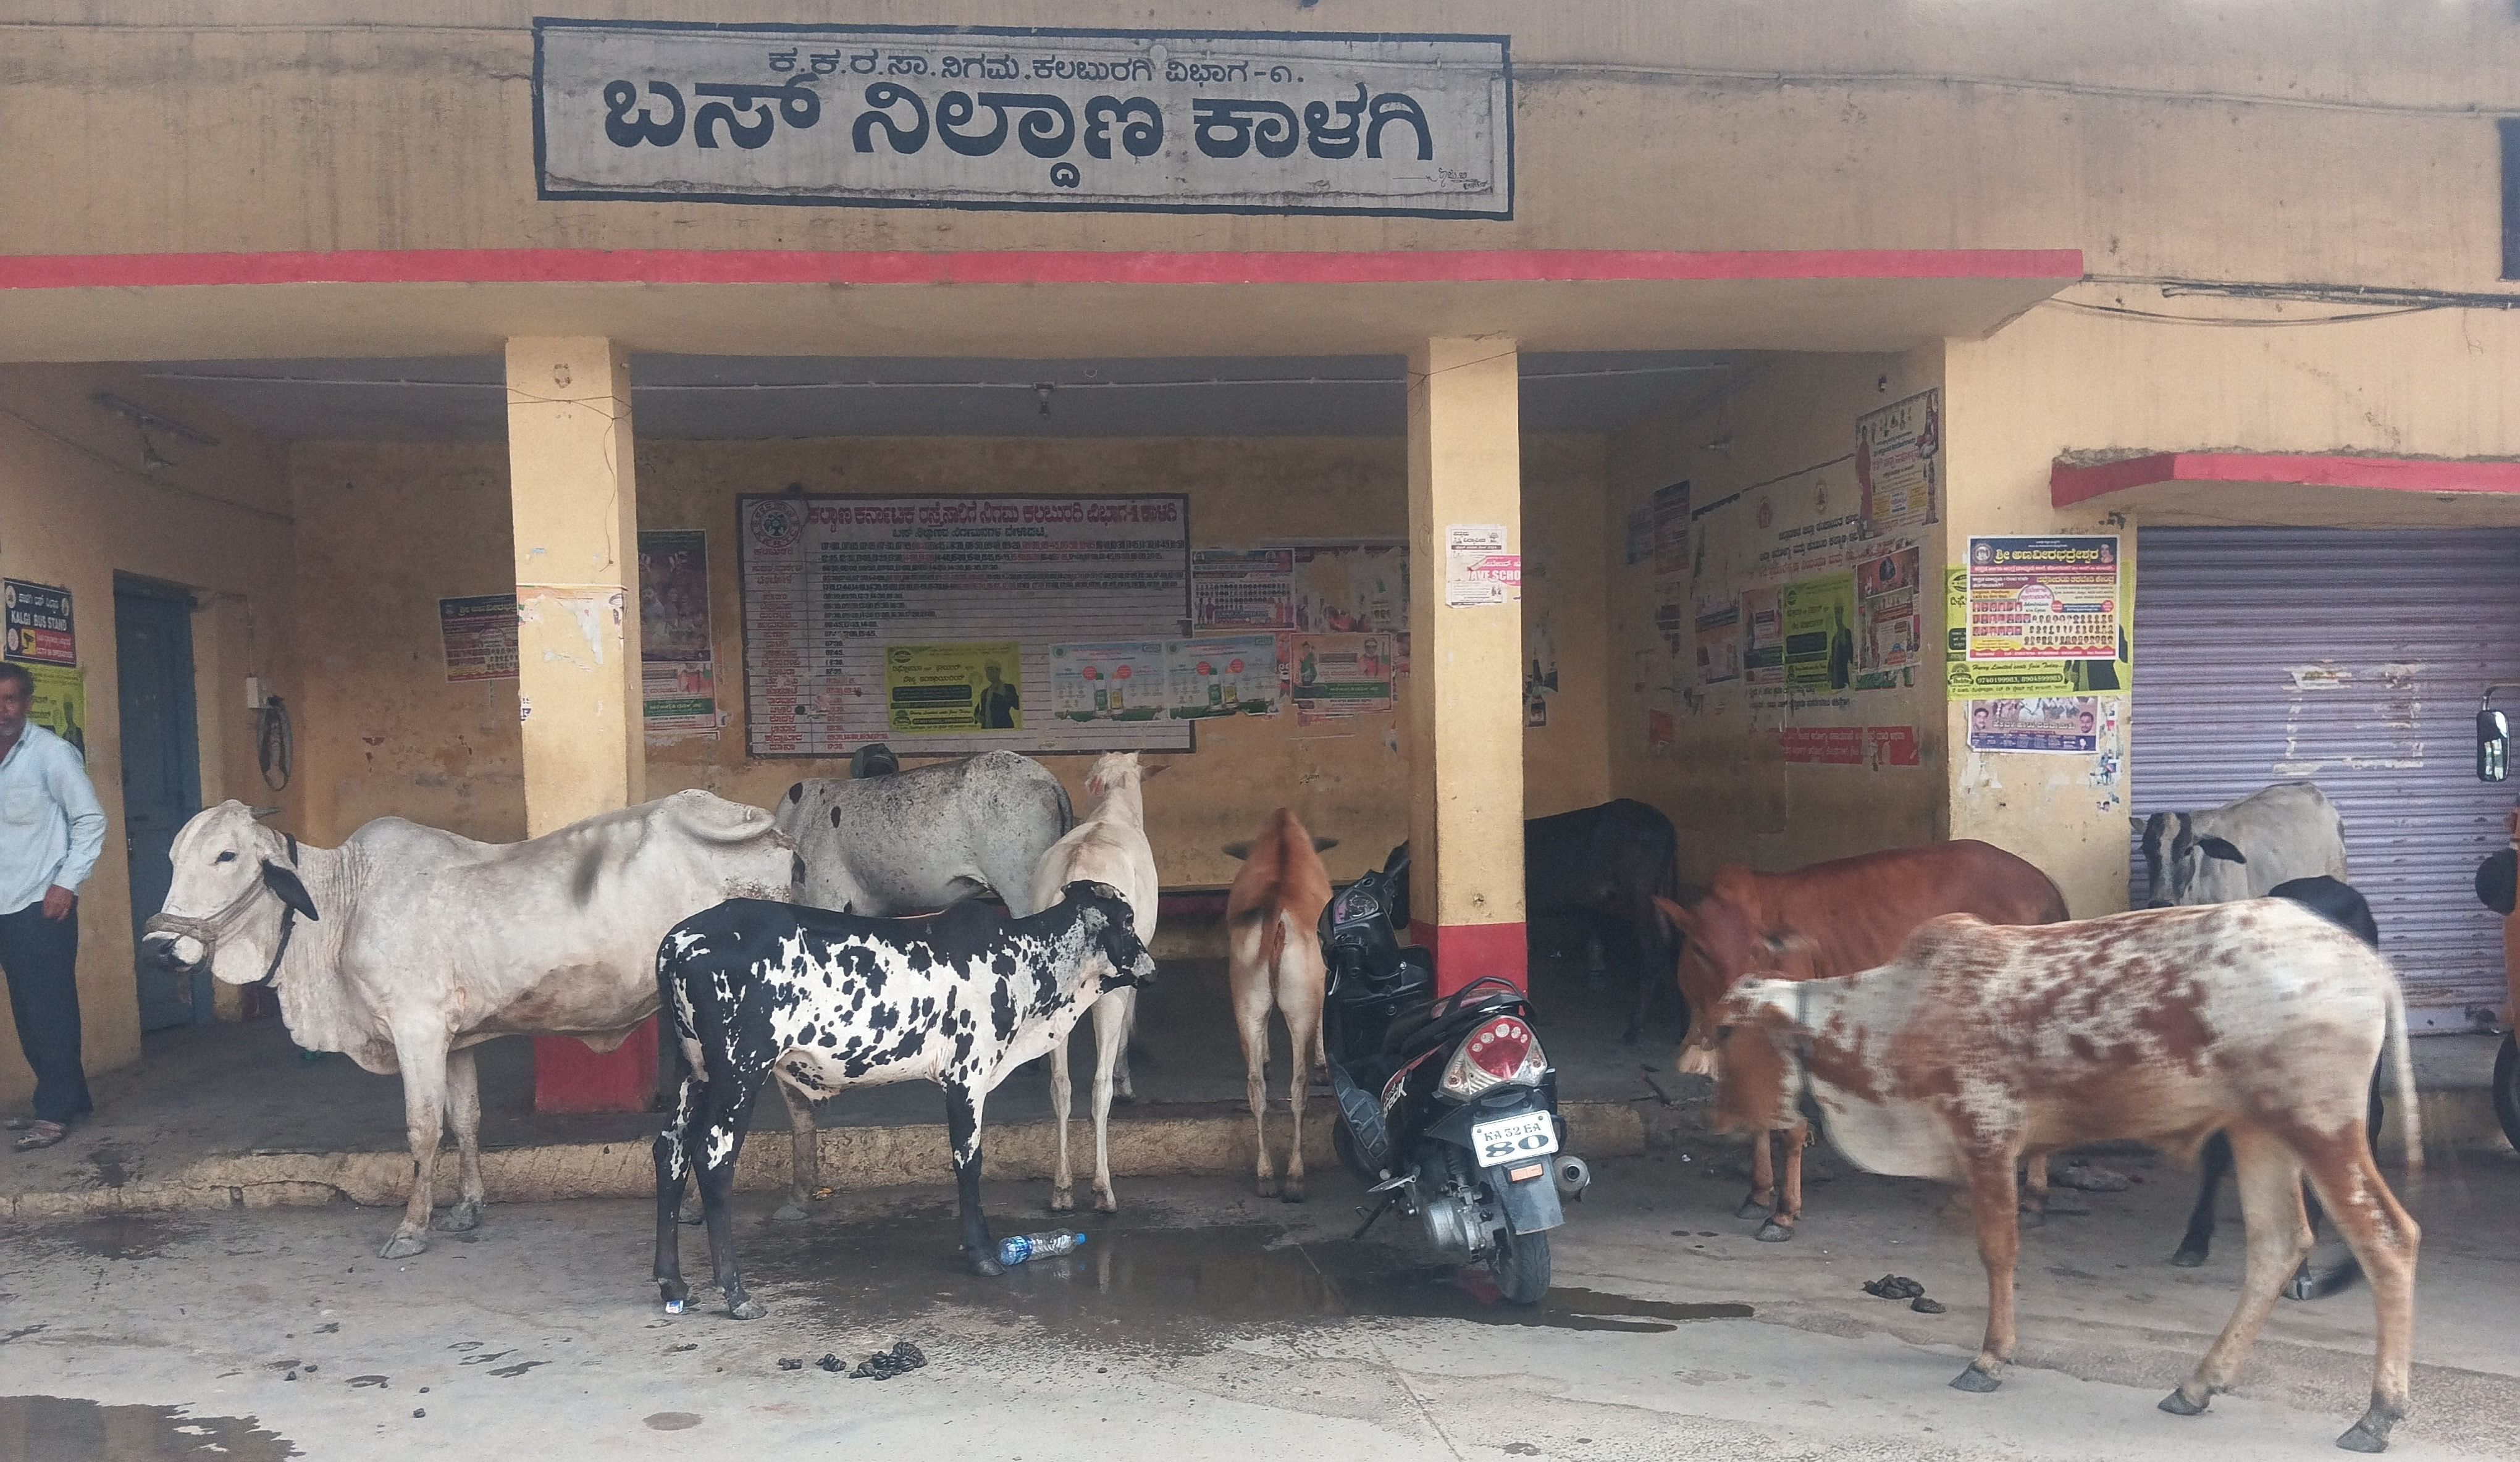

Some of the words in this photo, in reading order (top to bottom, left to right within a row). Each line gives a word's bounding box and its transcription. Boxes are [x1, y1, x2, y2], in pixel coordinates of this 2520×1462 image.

[603, 72, 821, 149] ಬಸ್
[852, 81, 1164, 188] ನಿಲ್ದಾಣ
[1193, 82, 1433, 161] ಕಾಳಗಿ
[980, 501, 1019, 525] ನಿಗಮ
[1994, 548, 2010, 564] ಶ್ರೀ
[11, 610, 31, 626] KALGI
[33, 614, 46, 629] BUS
[47, 616, 67, 632] STAND
[1484, 1131, 1502, 1141] KA
[1505, 1126, 1521, 1137] 32
[1523, 1122, 1542, 1133] EA
[1485, 1135, 1549, 1158] 80
